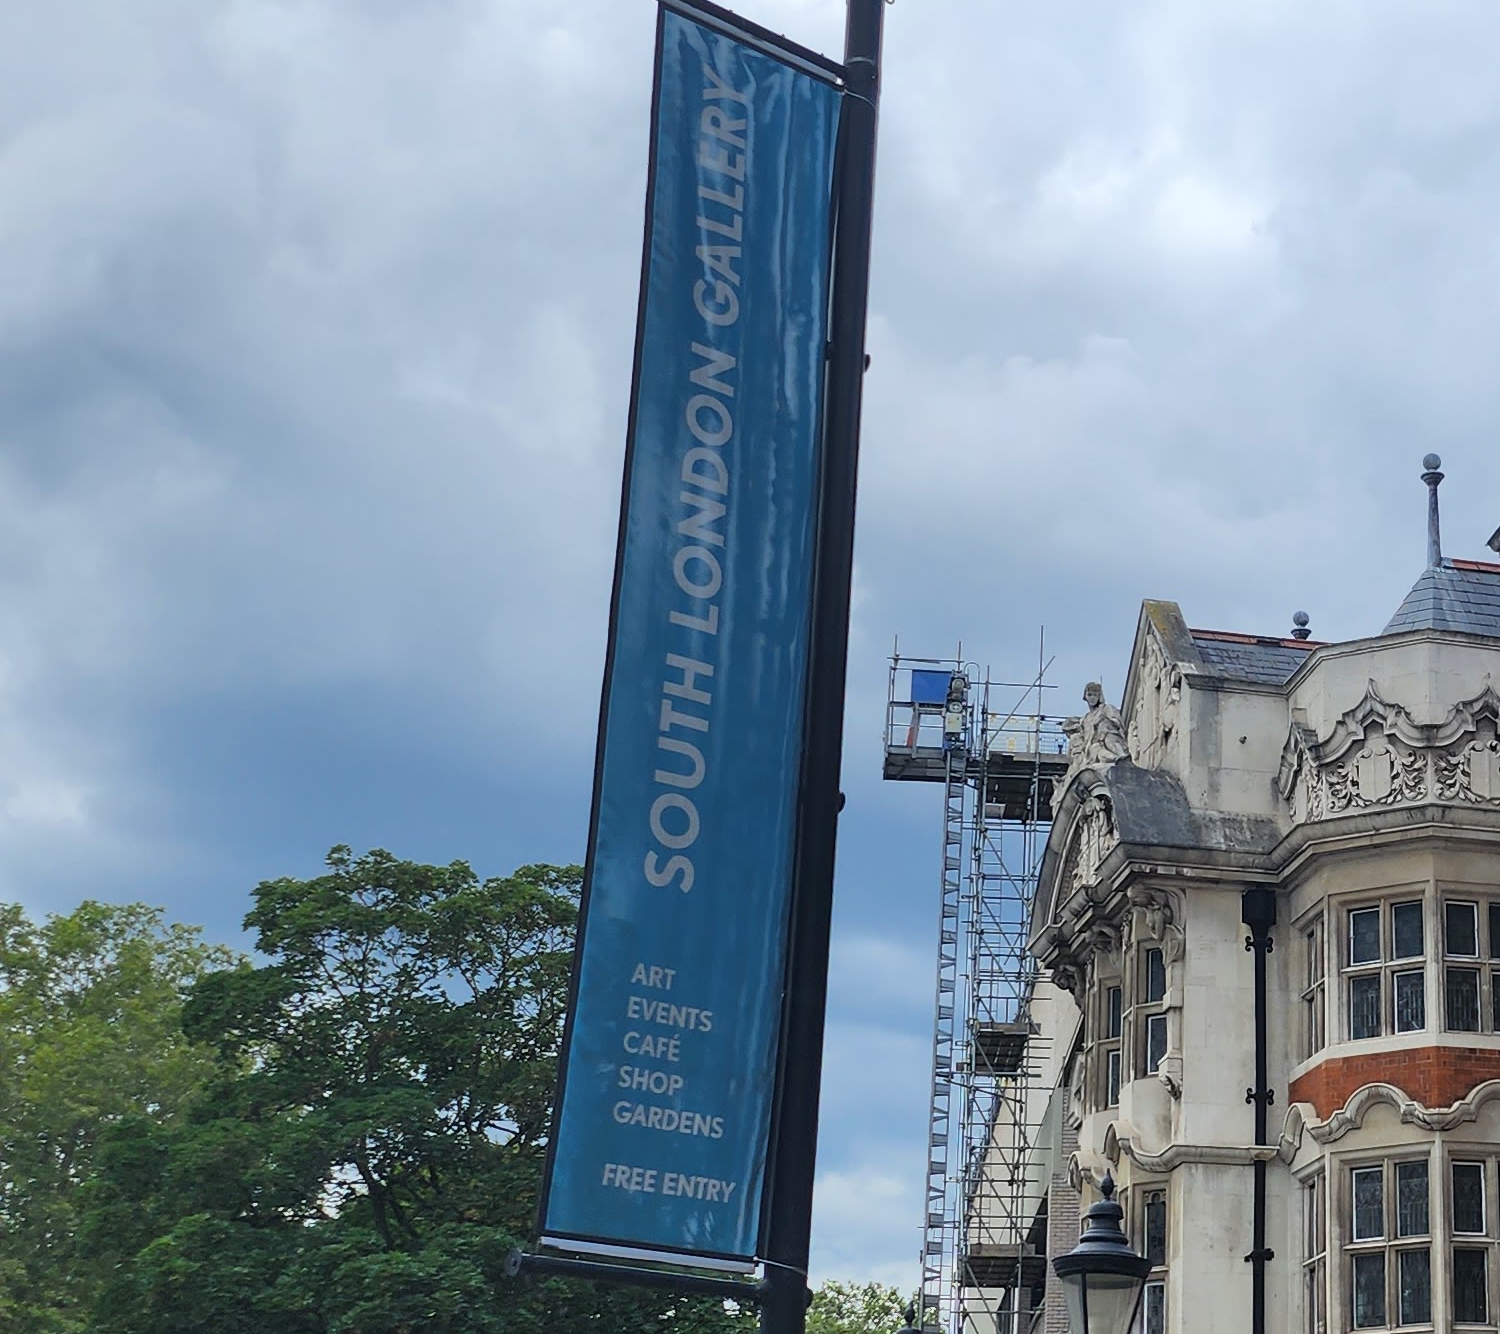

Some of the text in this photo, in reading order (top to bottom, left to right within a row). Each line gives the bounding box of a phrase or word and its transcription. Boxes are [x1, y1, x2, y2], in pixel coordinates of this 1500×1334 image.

[644, 63, 748, 893] SOUTH LONDON GALLERY
[631, 963, 676, 990] ART
[627, 996, 713, 1032] EVENTS
[623, 1034, 681, 1062] CAFÉ
[618, 1066, 684, 1096] SHOP
[613, 1100, 724, 1139] GARDENS
[602, 1163, 736, 1203] FREE ENTRY
